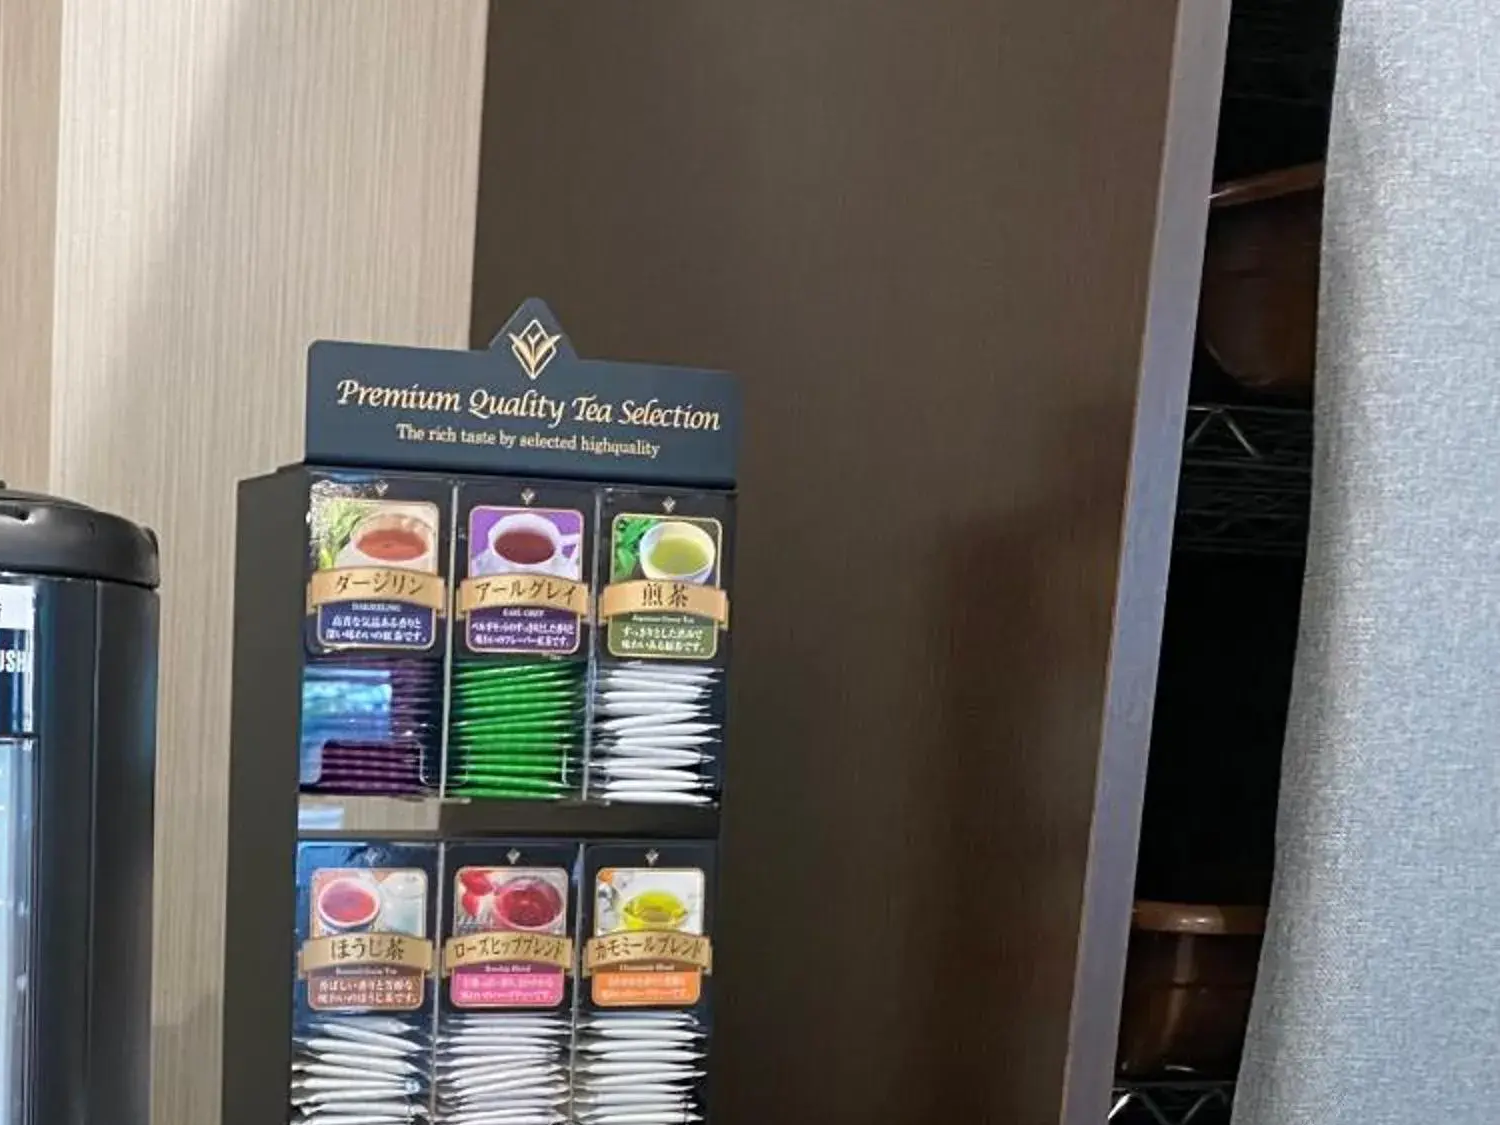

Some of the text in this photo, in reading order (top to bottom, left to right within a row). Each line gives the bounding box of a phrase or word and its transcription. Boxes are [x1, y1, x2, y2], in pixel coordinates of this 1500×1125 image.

[336, 379, 721, 432] Premium Quality Tea Selection
[396, 423, 660, 459] The rich taste by selected highquality
[335, 572, 423, 595] ダージリン
[475, 580, 576, 606] アールグレイ
[642, 583, 689, 608] 煎茶
[331, 937, 404, 960] ほうじ茶
[454, 936, 564, 959] ローズヒップブレンド
[595, 935, 703, 960] カモミールブレンド
